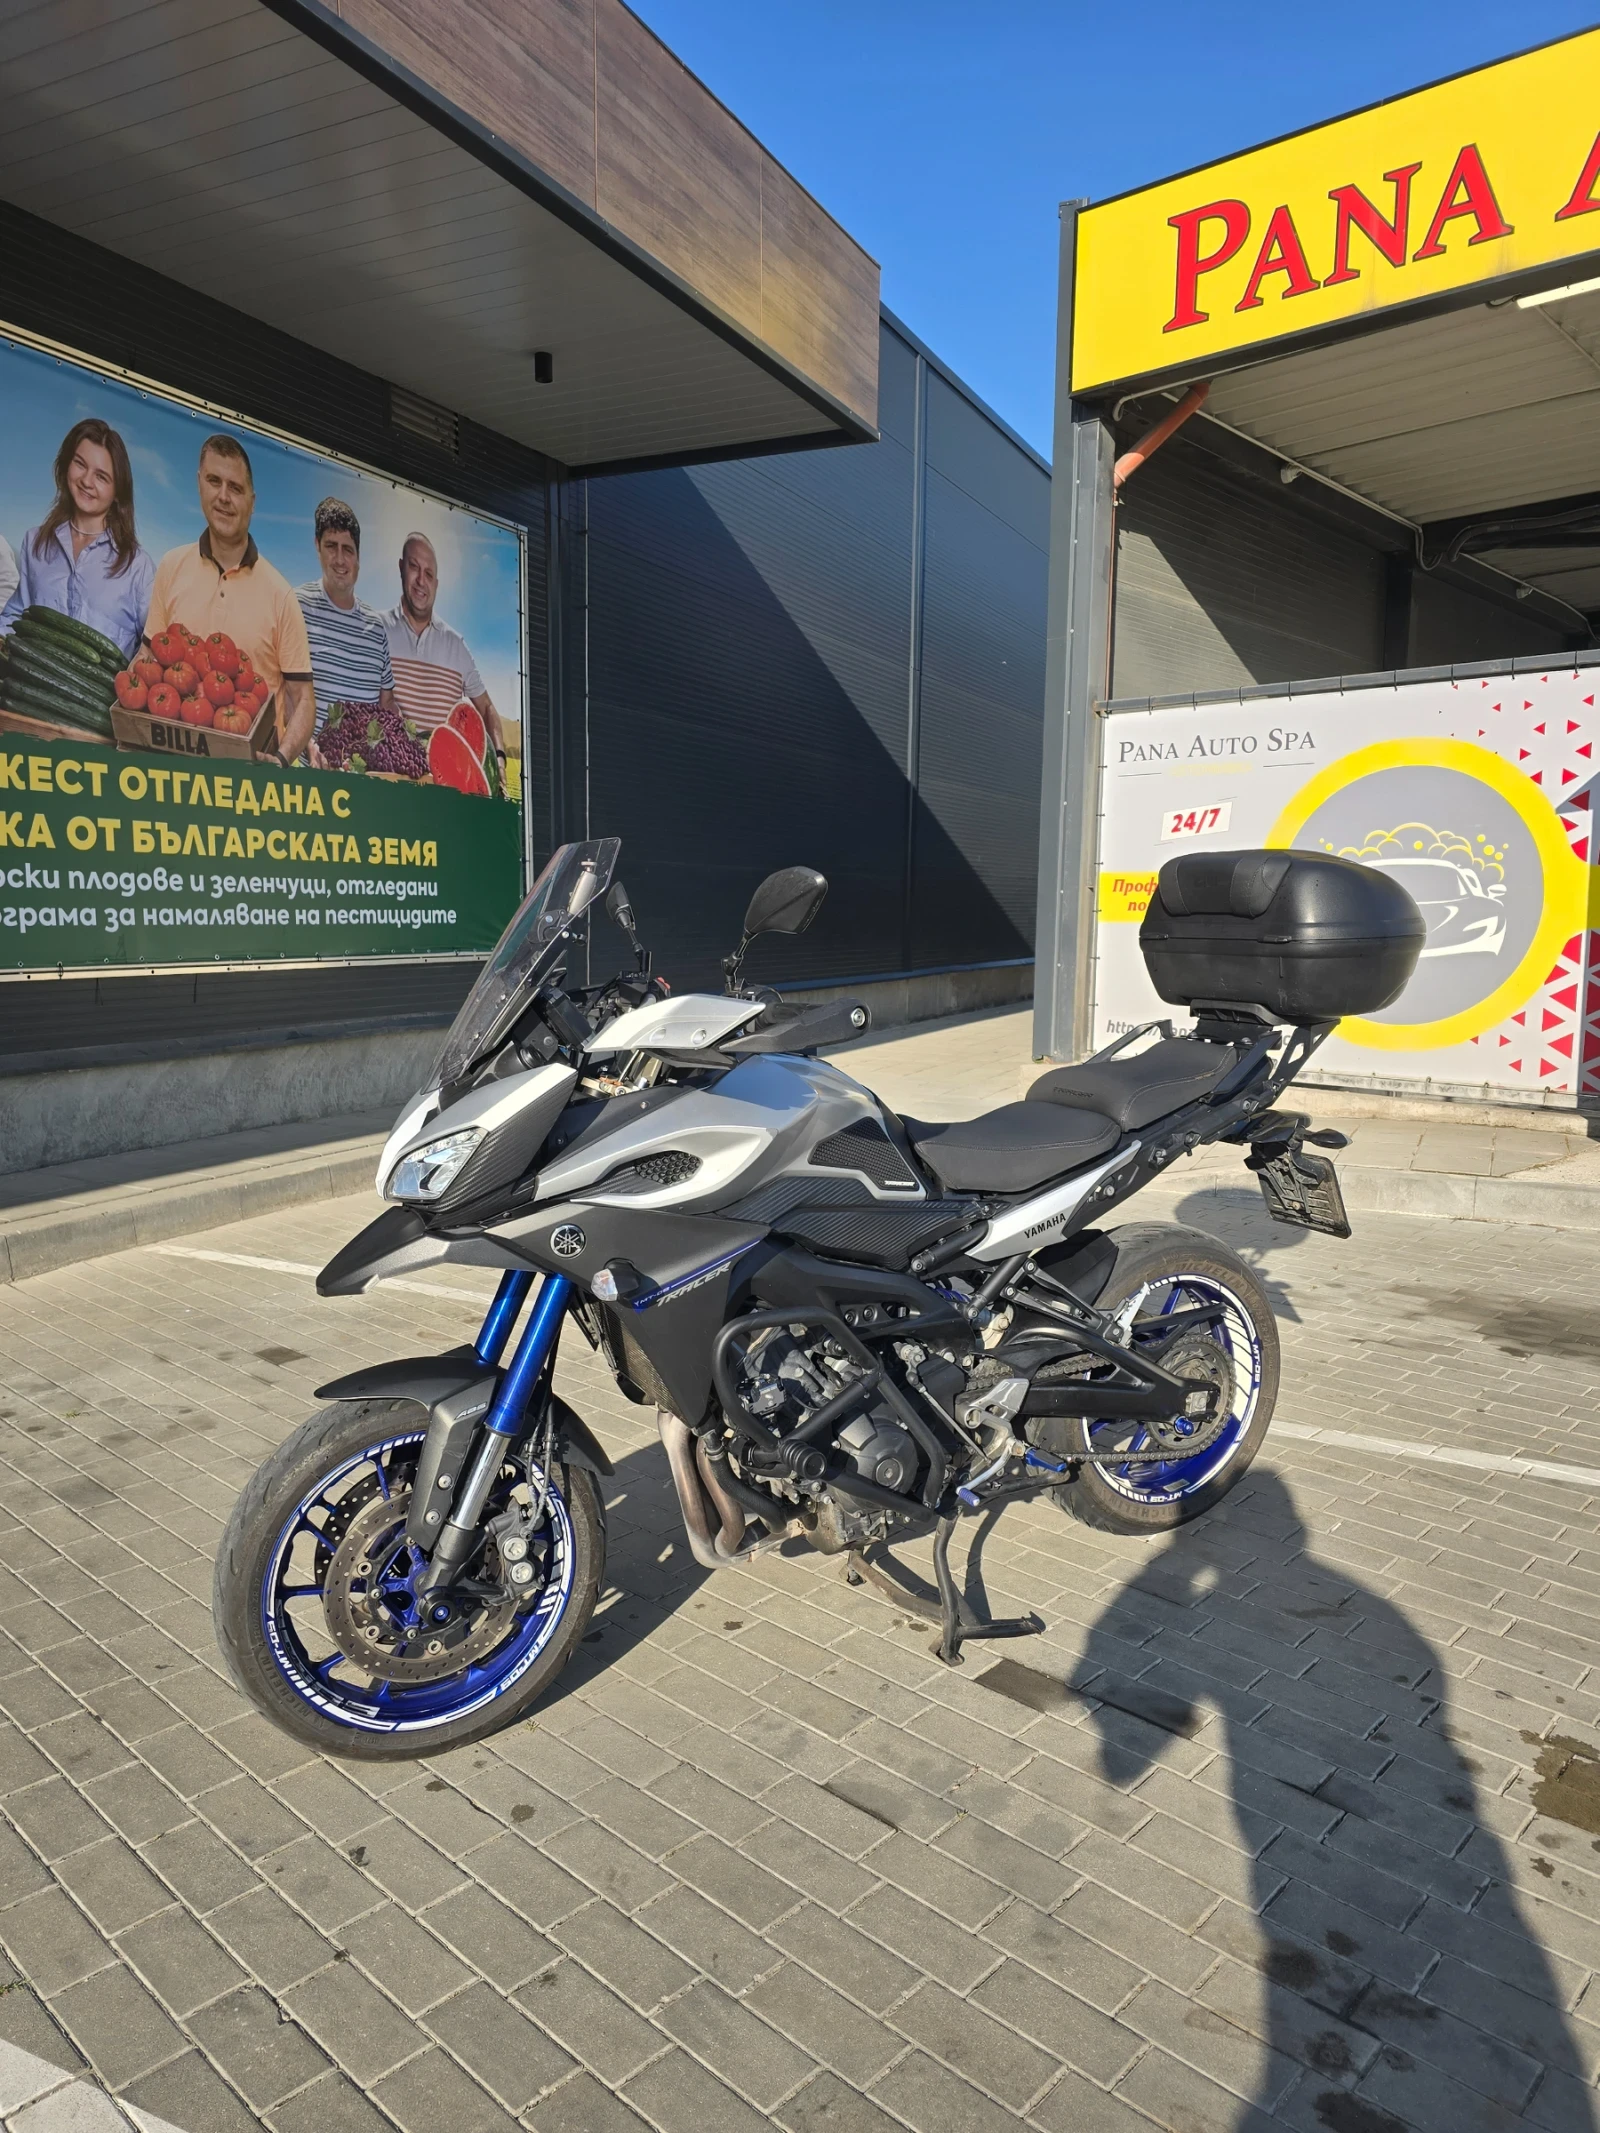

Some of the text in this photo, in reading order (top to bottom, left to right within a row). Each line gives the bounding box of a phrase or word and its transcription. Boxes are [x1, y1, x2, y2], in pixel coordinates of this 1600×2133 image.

[1162, 143, 1515, 334] PANA
[150, 722, 211, 758] BILLA
[118, 766, 325, 817] ОТГЛЕДАНА
[332, 789, 352, 818] С
[1171, 808, 1221, 834] 24/7
[66, 815, 121, 852] ОТ
[132, 820, 362, 863] БЪЛГАРСКАТА
[368, 837, 438, 867] ЗЕМЯ
[68, 866, 184, 898] плодове
[190, 874, 205, 892] и
[210, 874, 332, 900] зеленчуци,
[336, 879, 438, 902] отгледани
[104, 907, 136, 933] за
[143, 902, 290, 926] намаляване
[295, 908, 320, 926] на
[326, 908, 457, 930] пестицидите
[1024, 1213, 1067, 1239] YAMAHA
[656, 1260, 732, 1308] TRACER
[1252, 1344, 1261, 1383] MT-09
[1149, 1490, 1183, 1503] MT-09
[267, 1620, 292, 1669] MT-09
[260, 1654, 311, 1717] MICHELIN
